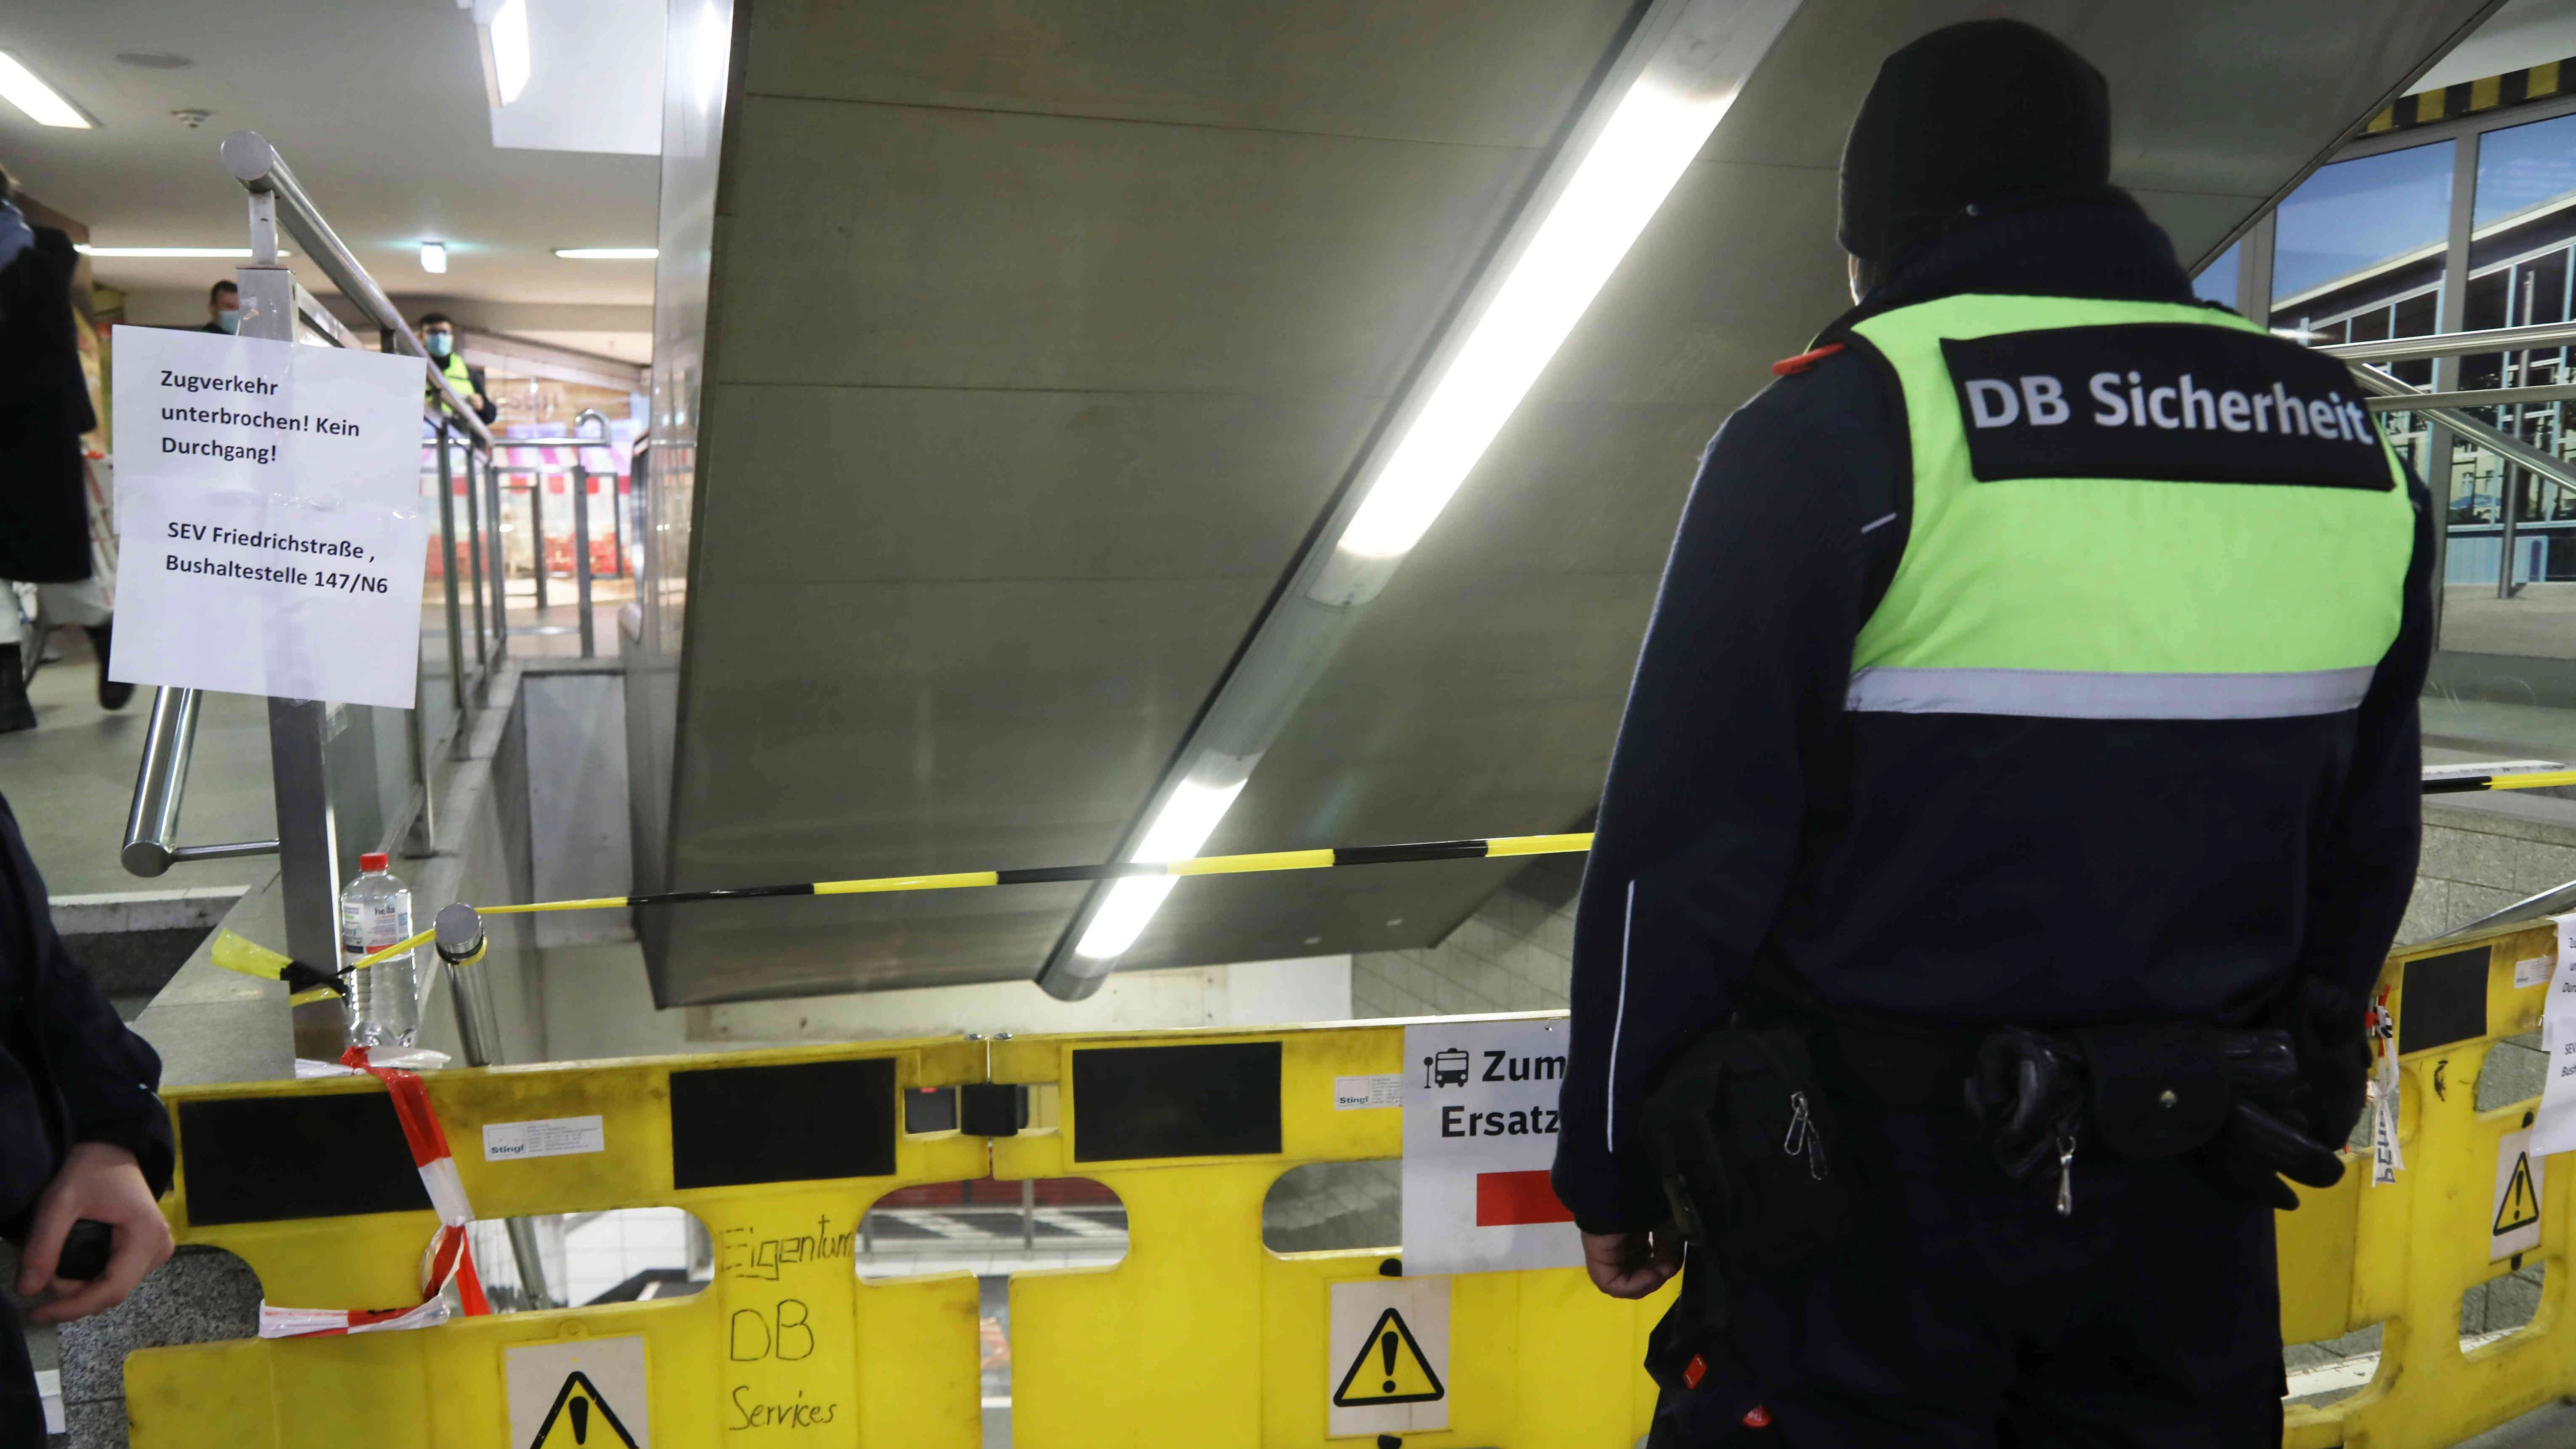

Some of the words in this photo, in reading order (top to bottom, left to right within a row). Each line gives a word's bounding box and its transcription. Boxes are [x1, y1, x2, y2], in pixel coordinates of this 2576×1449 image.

[161, 370, 278, 395] Zugverkehr
[162, 407, 308, 431] unterbrochen!
[316, 415, 359, 437] Kein
[1965, 376, 2070, 428] DB
[2090, 371, 2374, 444] Sicherheit
[162, 437, 276, 465] Durchgang!
[168, 522, 207, 541] SEV
[213, 527, 363, 559] Friedrichstraße
[166, 555, 307, 585] Bushaltestelle
[315, 571, 387, 593] 147/N6
[1482, 1051, 1567, 1081] Zum
[1442, 1106, 1561, 1137] Ersatz
[491, 1144, 524, 1154] Stingl
[718, 1214, 854, 1281] Eigentum
[731, 1299, 814, 1361] DB
[729, 1385, 837, 1430] Services
